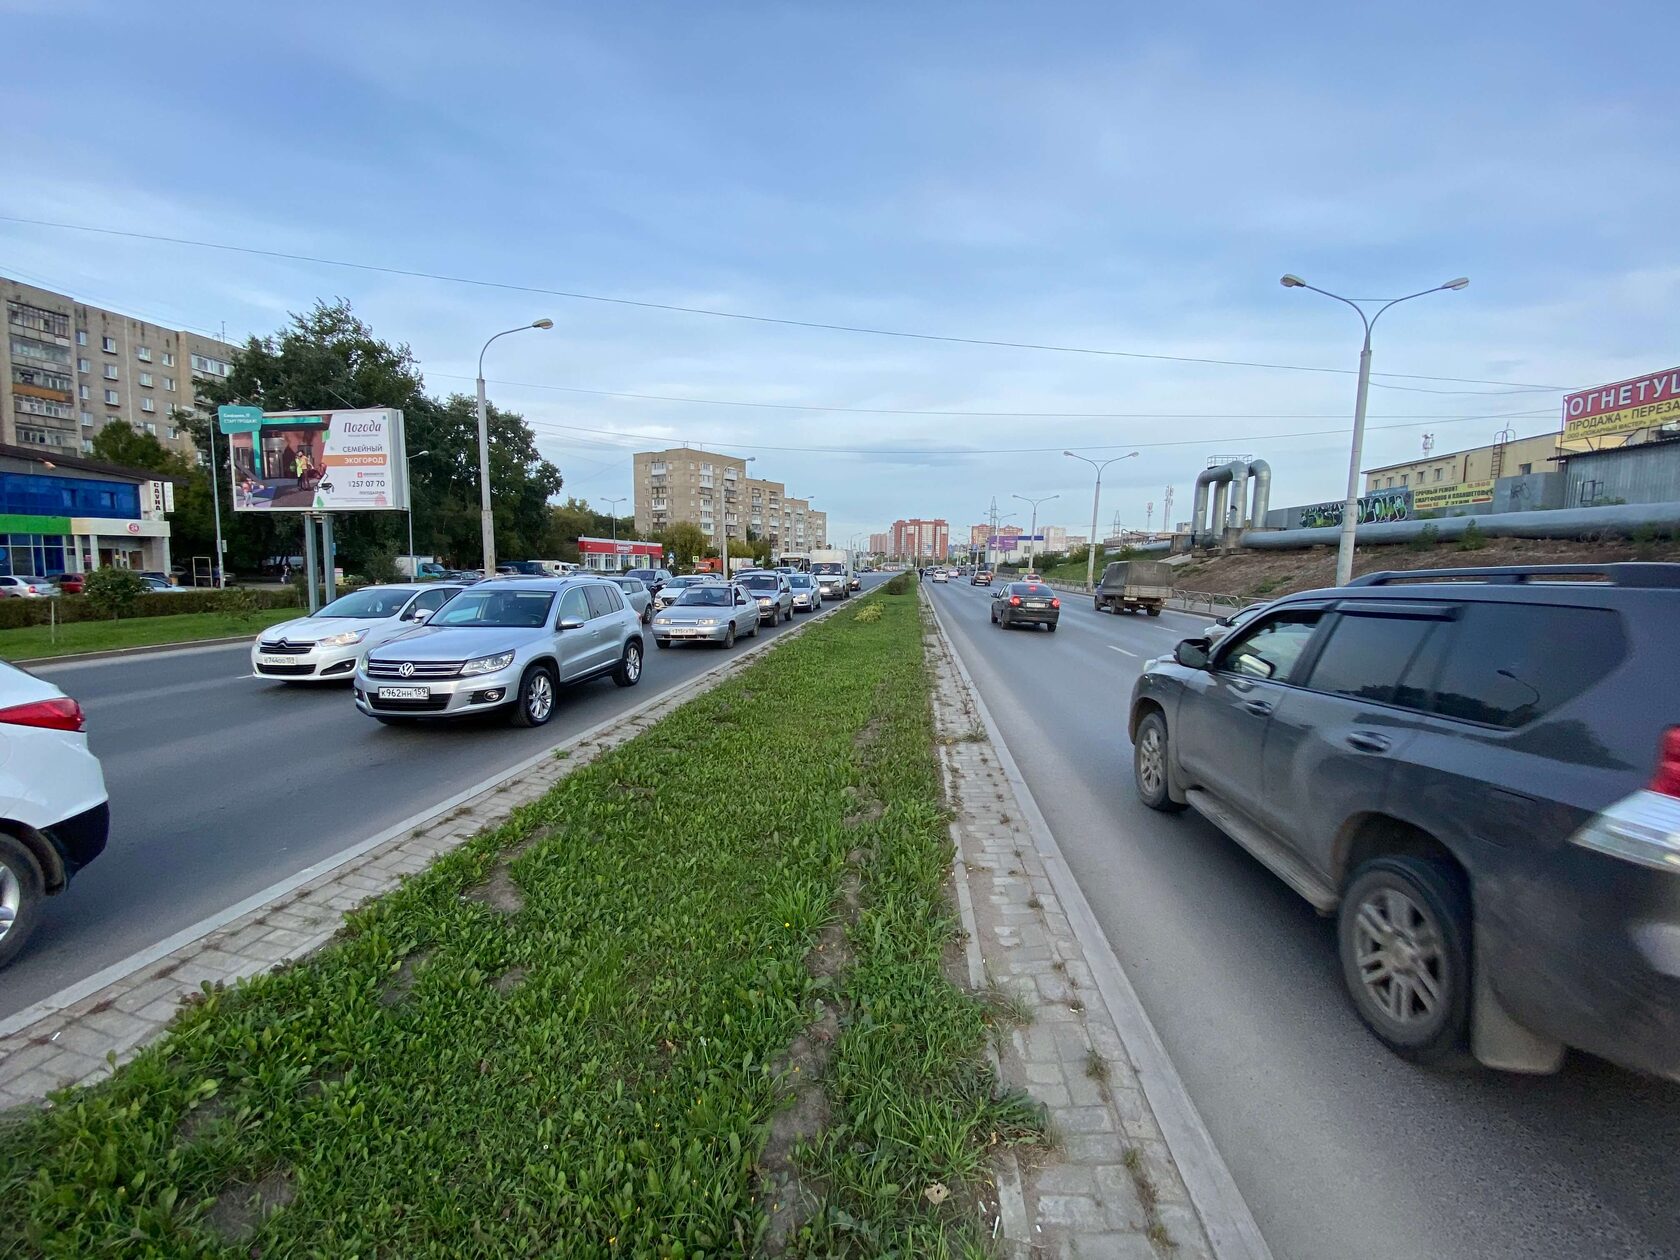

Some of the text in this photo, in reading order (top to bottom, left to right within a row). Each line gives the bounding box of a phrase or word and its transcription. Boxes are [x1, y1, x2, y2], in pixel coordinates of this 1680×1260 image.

[343, 420, 382, 433] Погода
[1568, 412, 1622, 432] ПРОДАЖА
[342, 443, 383, 453] СЕМЕЙНЫЙ
[1438, 485, 1458, 493] РЕМОНТ
[153, 482, 161, 511] САУНА
